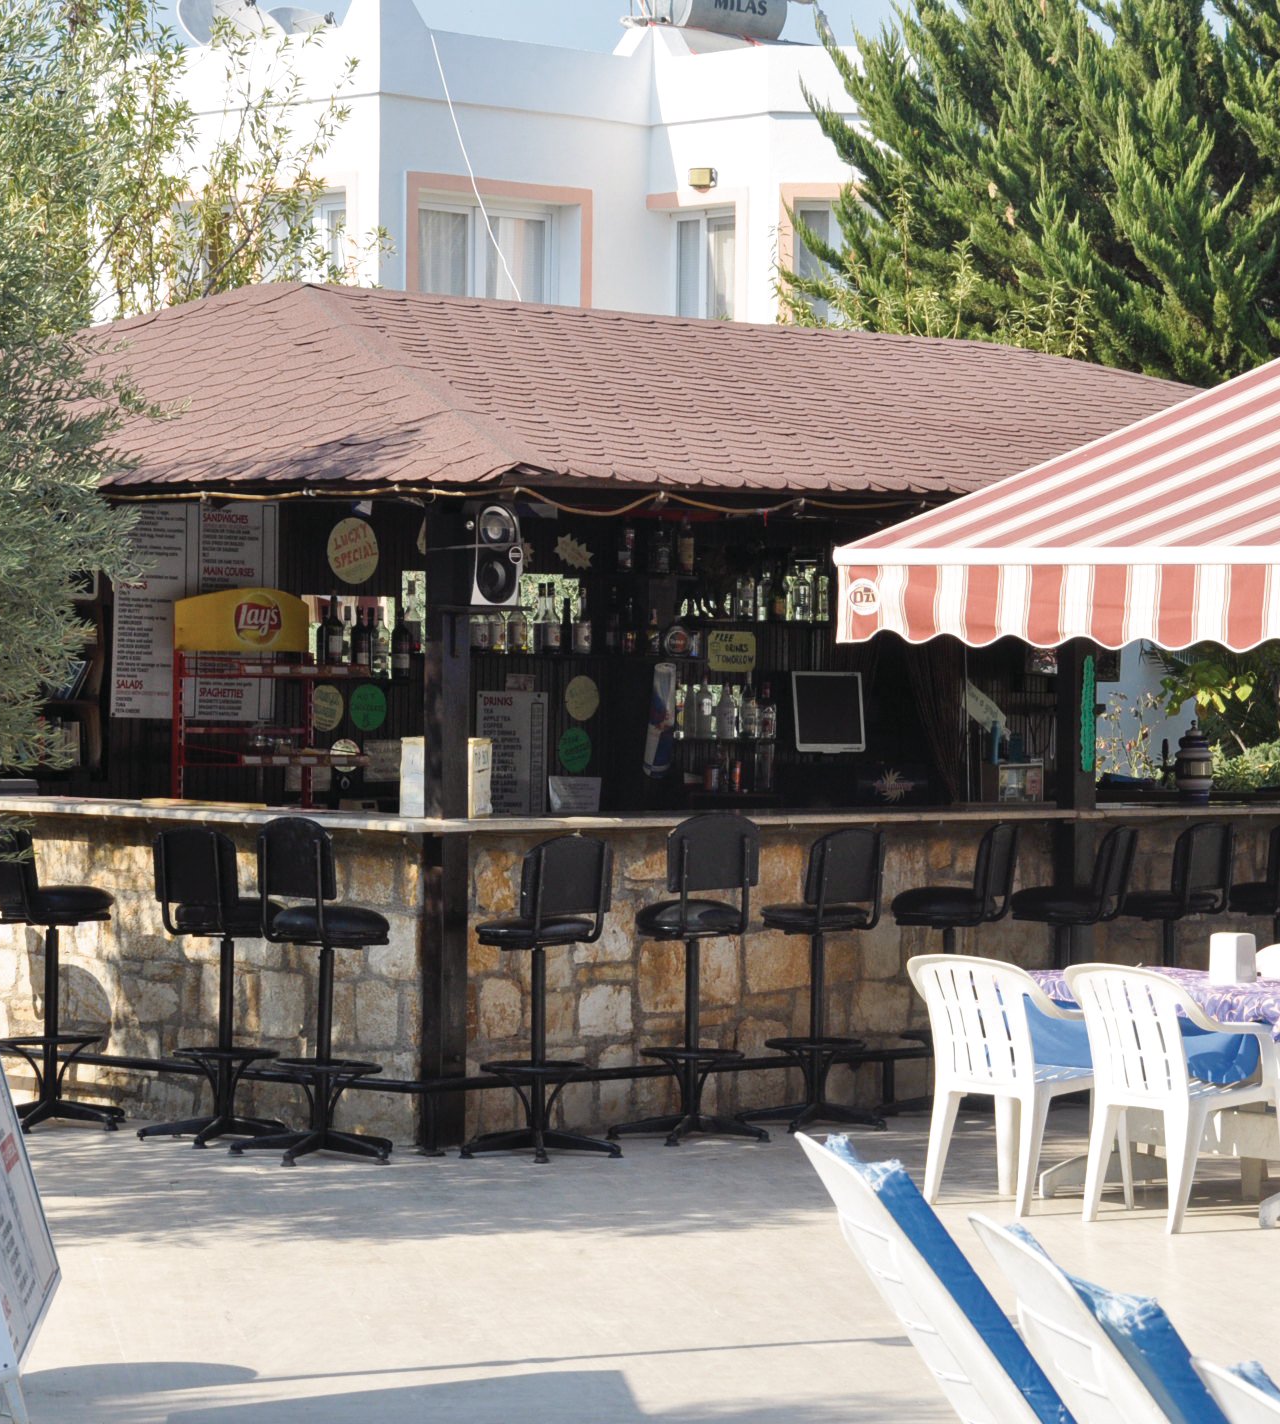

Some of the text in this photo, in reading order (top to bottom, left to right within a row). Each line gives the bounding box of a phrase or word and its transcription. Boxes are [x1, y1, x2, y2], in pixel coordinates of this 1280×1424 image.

[714, 0, 767, 16] MILAS
[203, 513, 248, 524] SANDWICHES
[334, 522, 368, 550] LUCKY
[334, 540, 378, 568] SPECIAL
[203, 566, 255, 577] MAIN COURSES
[119, 581, 147, 590] SNKS
[238, 604, 278, 636] Lay's
[715, 633, 735, 642] FREE
[715, 655, 754, 664] TOMORROW
[116, 680, 143, 690] SALADS
[199, 688, 244, 698] SPAGHETTIES
[484, 696, 513, 706] DRINKS
